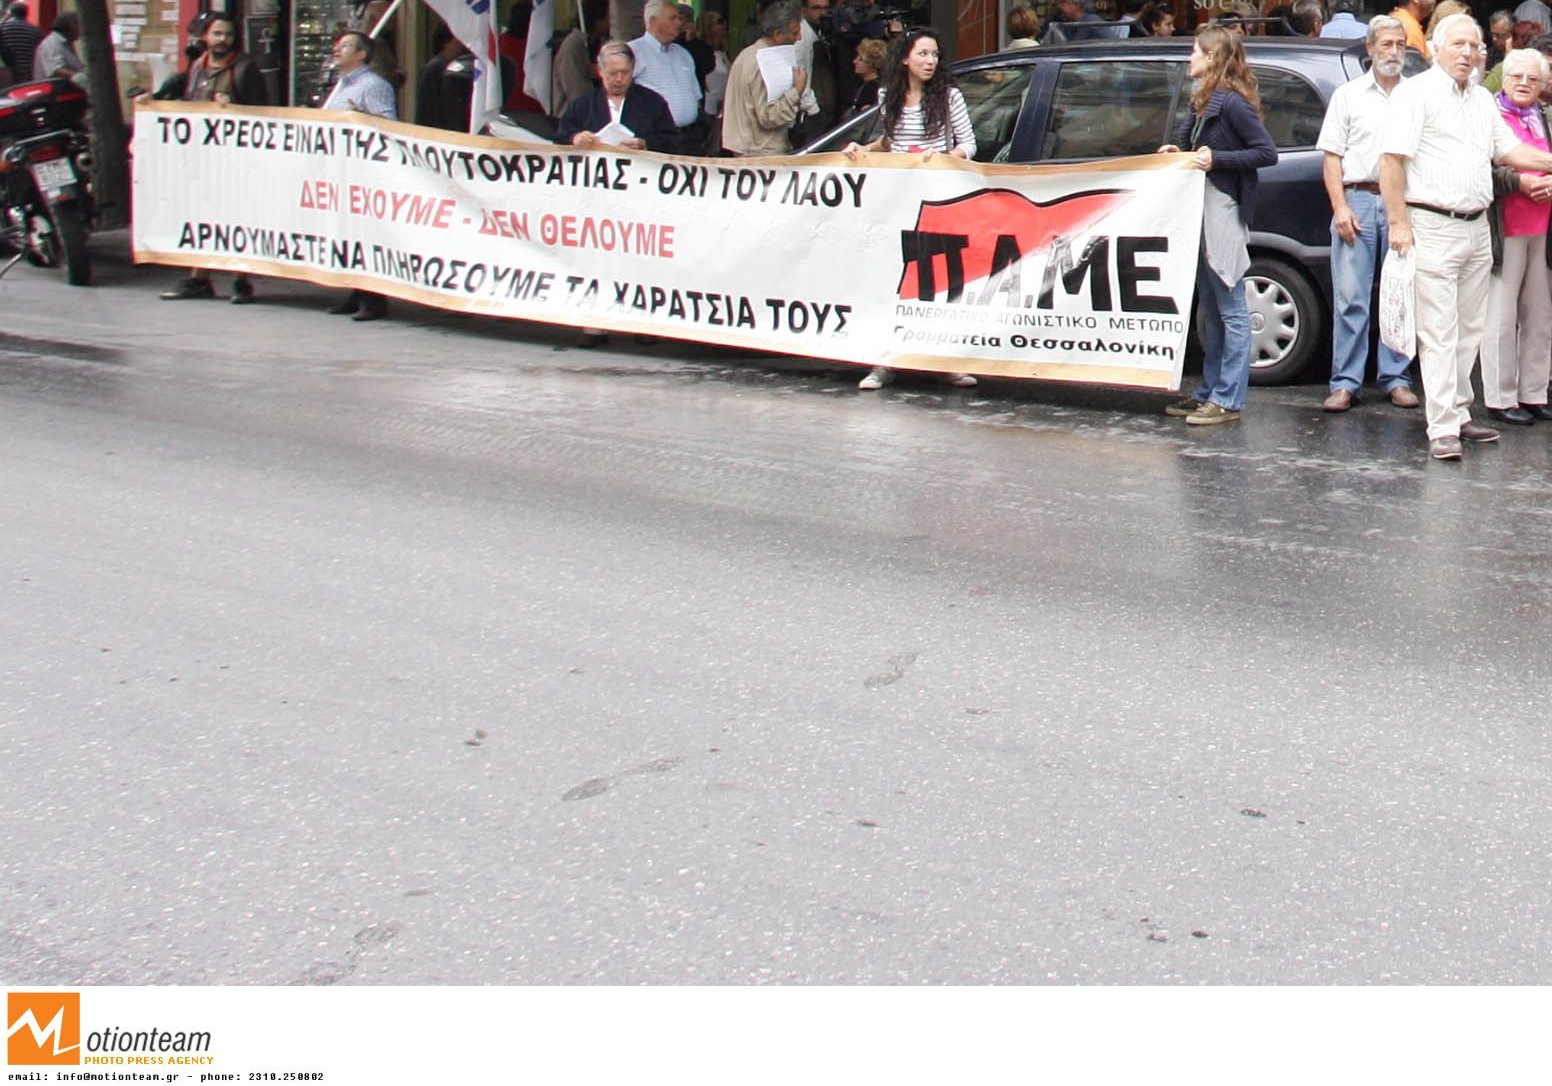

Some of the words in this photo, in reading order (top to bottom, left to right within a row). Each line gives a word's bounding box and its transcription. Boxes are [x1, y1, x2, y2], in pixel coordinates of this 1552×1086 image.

[157, 117, 192, 145] ΤΟ
[203, 117, 277, 155] ΧΡΕΟΣ
[283, 124, 336, 156] ΕΙΝΑΙ
[341, 128, 390, 162] ΤΗΣ
[658, 162, 708, 198] ΟΧΙ
[719, 168, 775, 202] ΤΟΥ
[780, 170, 867, 208] ΛΑΟΥ
[300, 180, 339, 211] ΔΕΝ
[350, 185, 457, 229] ΕΧΟΥΜΕ
[478, 209, 531, 242] ΔΕΝ
[540, 214, 675, 258] ΘΕΛΟΥΜΕ
[178, 221, 327, 261] ΑΡΝΟΥΜΑΣΤΕ
[331, 240, 365, 270] ΝΑ
[372, 245, 555, 302] ΠΛΗΡΩΣΟΥΜΕ
[565, 275, 600, 307] ΤΑ
[613, 281, 756, 330] ΧΑΡΑΤΣΙΑ
[766, 298, 853, 338] ΤΟΥΣ
[996, 311, 1097, 330] ΑΓΩΝΙΣΤΙΚΟ
[1109, 317, 1184, 334] ΜΕΤΩΠΟ
[1009, 333, 1175, 361] Θεσσαλονίκη
